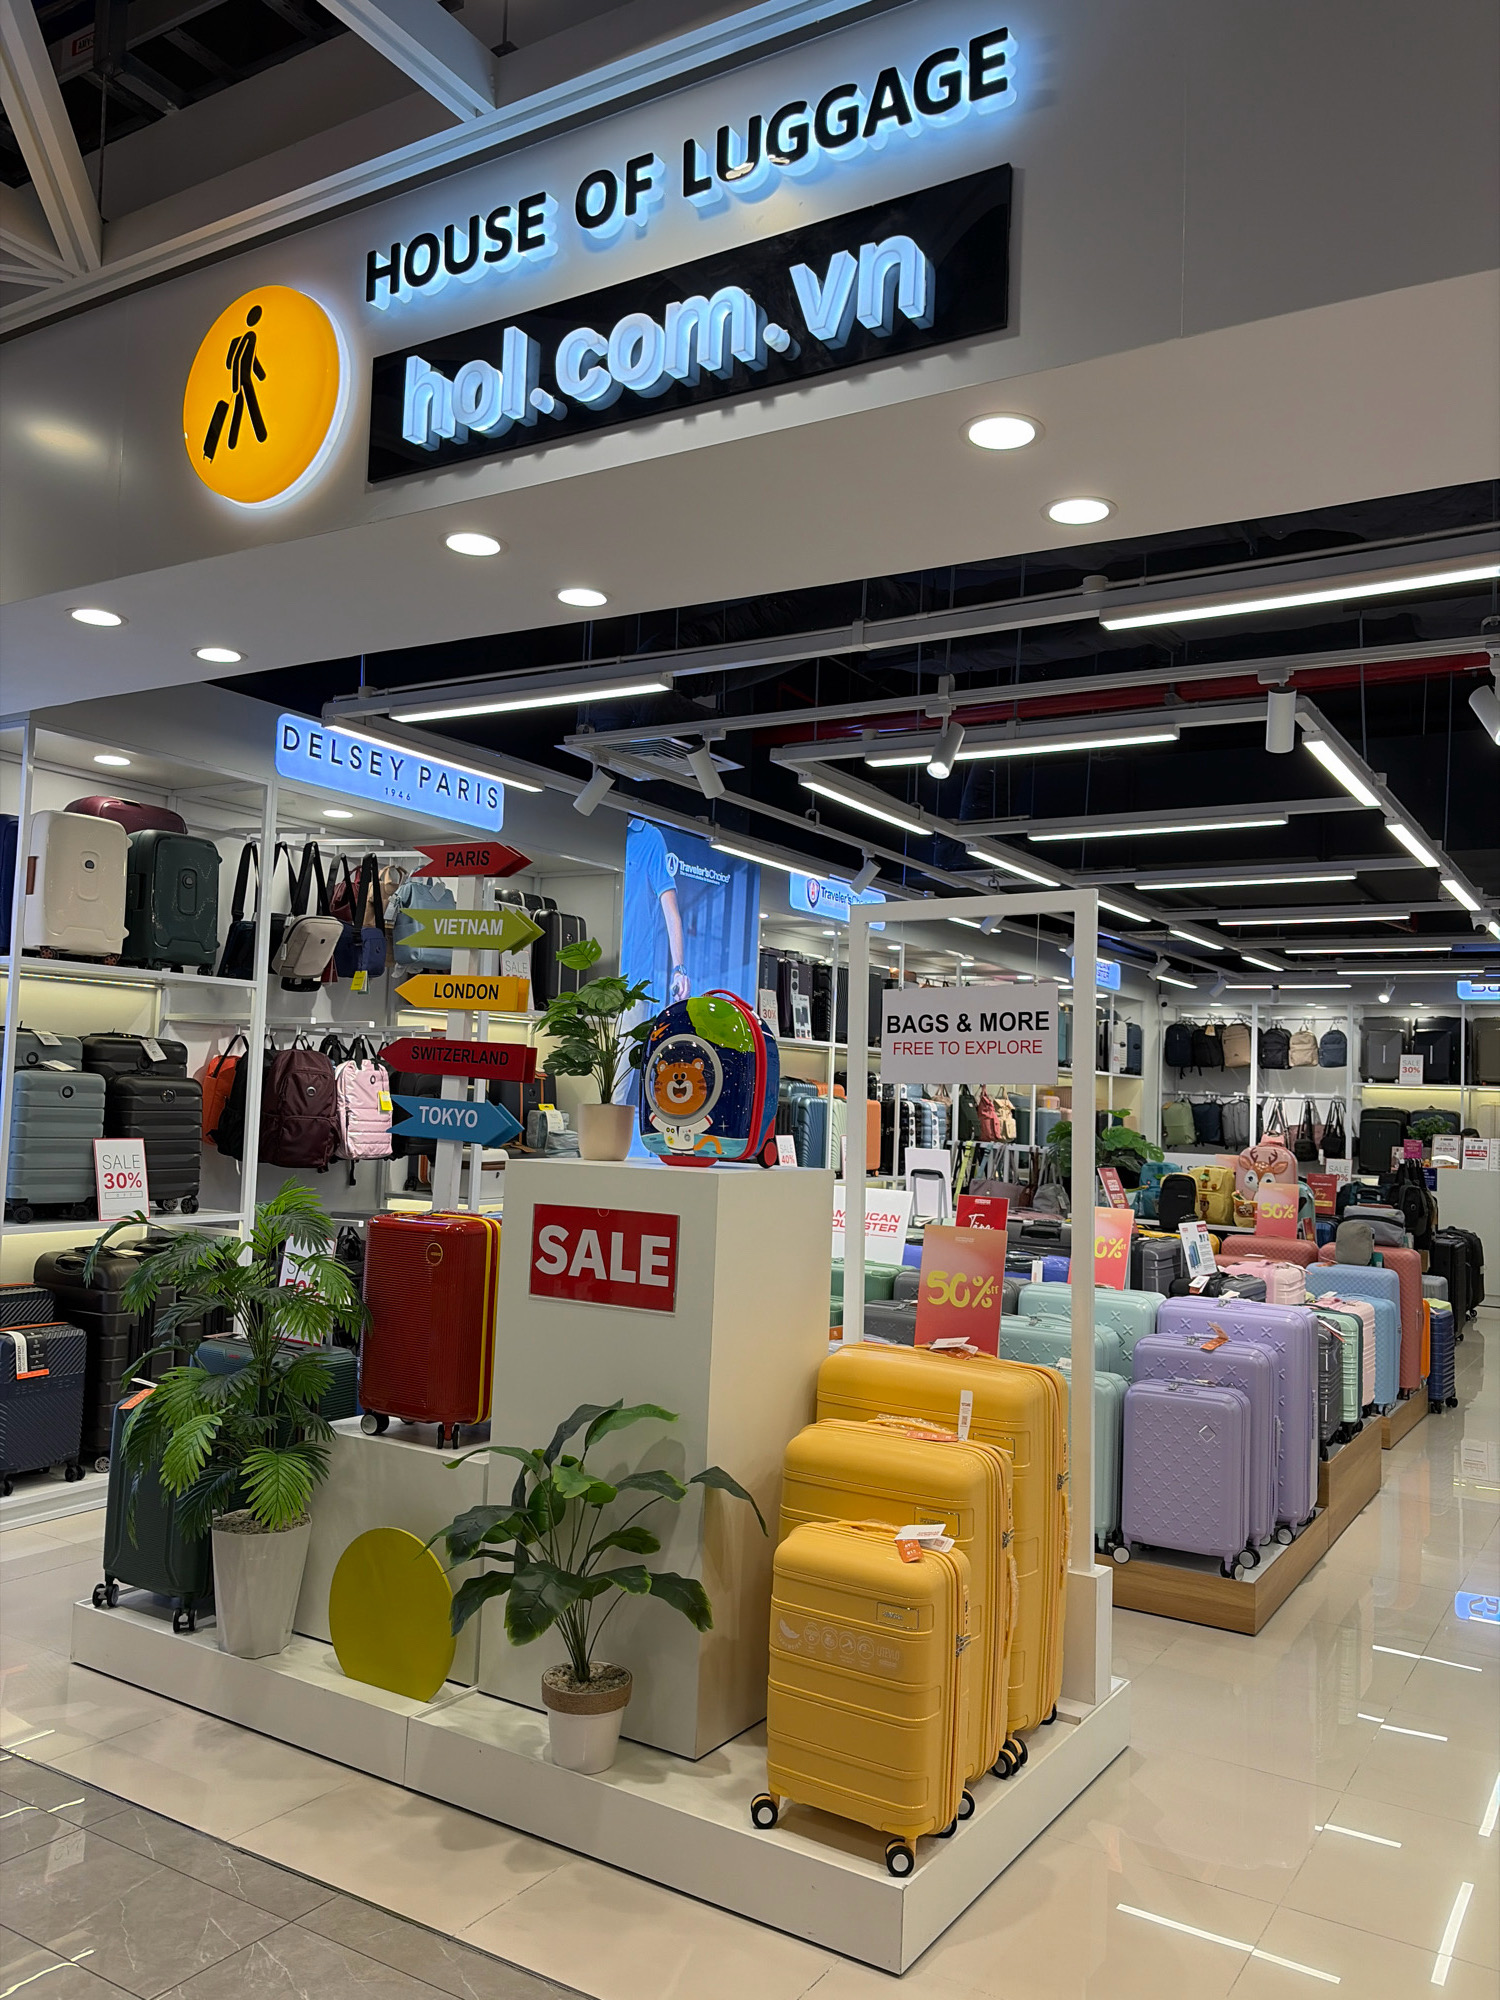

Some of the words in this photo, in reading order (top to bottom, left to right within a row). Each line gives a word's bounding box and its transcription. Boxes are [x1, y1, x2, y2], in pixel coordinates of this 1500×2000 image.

[366, 191, 547, 303] HOUSE
[575, 152, 654, 229] OF
[683, 26, 1009, 199] LUGGAGE
[402, 235, 934, 451] hol.com.vn
[283, 724, 405, 781] DELSEY
[419, 766, 498, 809] PARIS
[384, 787, 411, 801] 1946
[445, 850, 491, 868] PARIS
[433, 918, 504, 936] VIETNAM
[505, 960, 528, 975] SALE
[433, 982, 500, 1000] LONDON
[762, 999, 777, 1009] SALE
[762, 1008, 777, 1019] 30%
[887, 1013, 949, 1034] BAGS
[956, 1013, 972, 1033] &
[980, 1011, 1050, 1032] MORE
[411, 1045, 509, 1066] SWITZERLAND
[893, 1041, 934, 1055] FREE
[938, 1041, 960, 1055] TO
[965, 1039, 1043, 1055] EXPLORE
[1402, 1066, 1421, 1074] 30%
[419, 1105, 478, 1128] TOKYO
[779, 1143, 794, 1154] SALE
[102, 1154, 141, 1170] SALE
[781, 1154, 795, 1164] 40%
[1328, 1165, 1350, 1174] SALE
[103, 1171, 142, 1190] 30%
[1260, 1202, 1296, 1219] 50%
[535, 1224, 670, 1288] SALE
[927, 1270, 994, 1309] 50%
